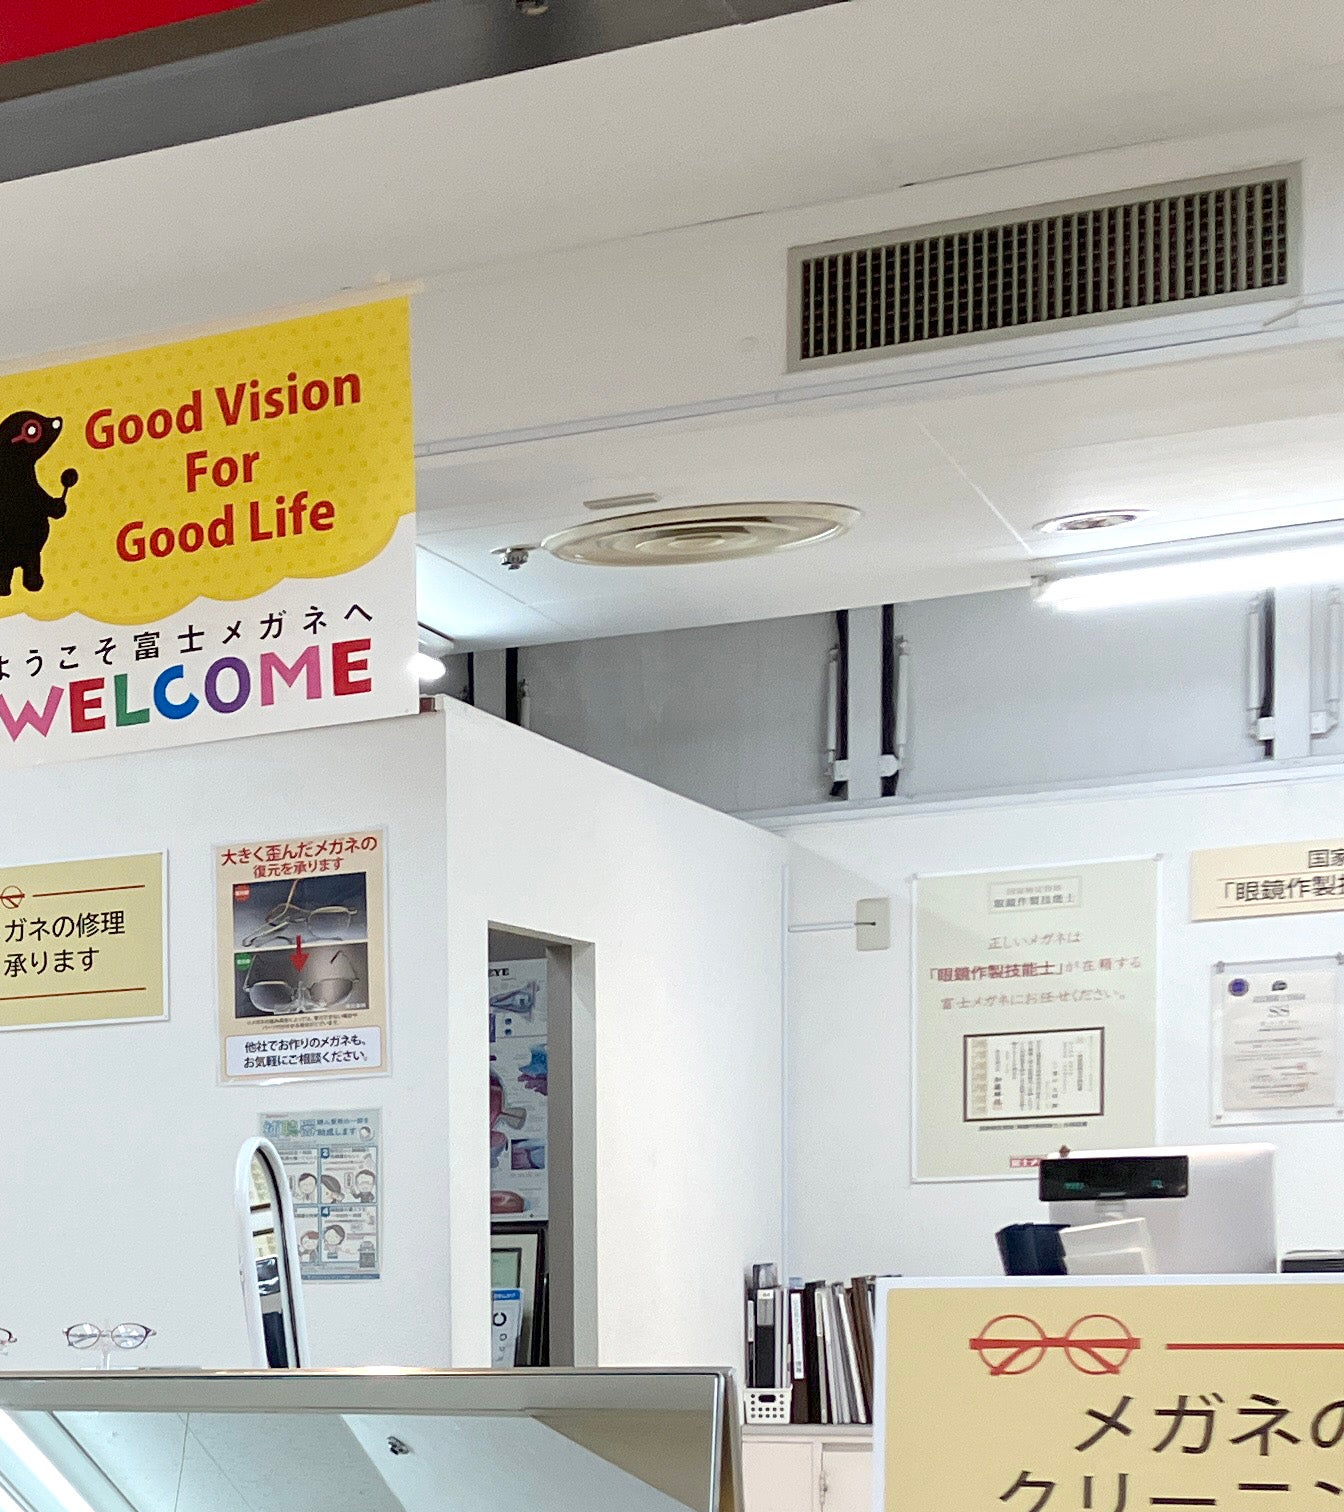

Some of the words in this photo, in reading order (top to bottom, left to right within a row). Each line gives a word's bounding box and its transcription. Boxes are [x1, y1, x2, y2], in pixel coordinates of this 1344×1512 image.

[85, 389, 204, 450] Good
[215, 370, 362, 427] Vision
[185, 448, 261, 494] For
[115, 503, 234, 563] Good
[249, 490, 336, 543] Life
[221, 836, 378, 866] 大きく歪んだメガネの
[253, 857, 344, 879] 復元を承ります
[3, 947, 100, 978] 承ります
